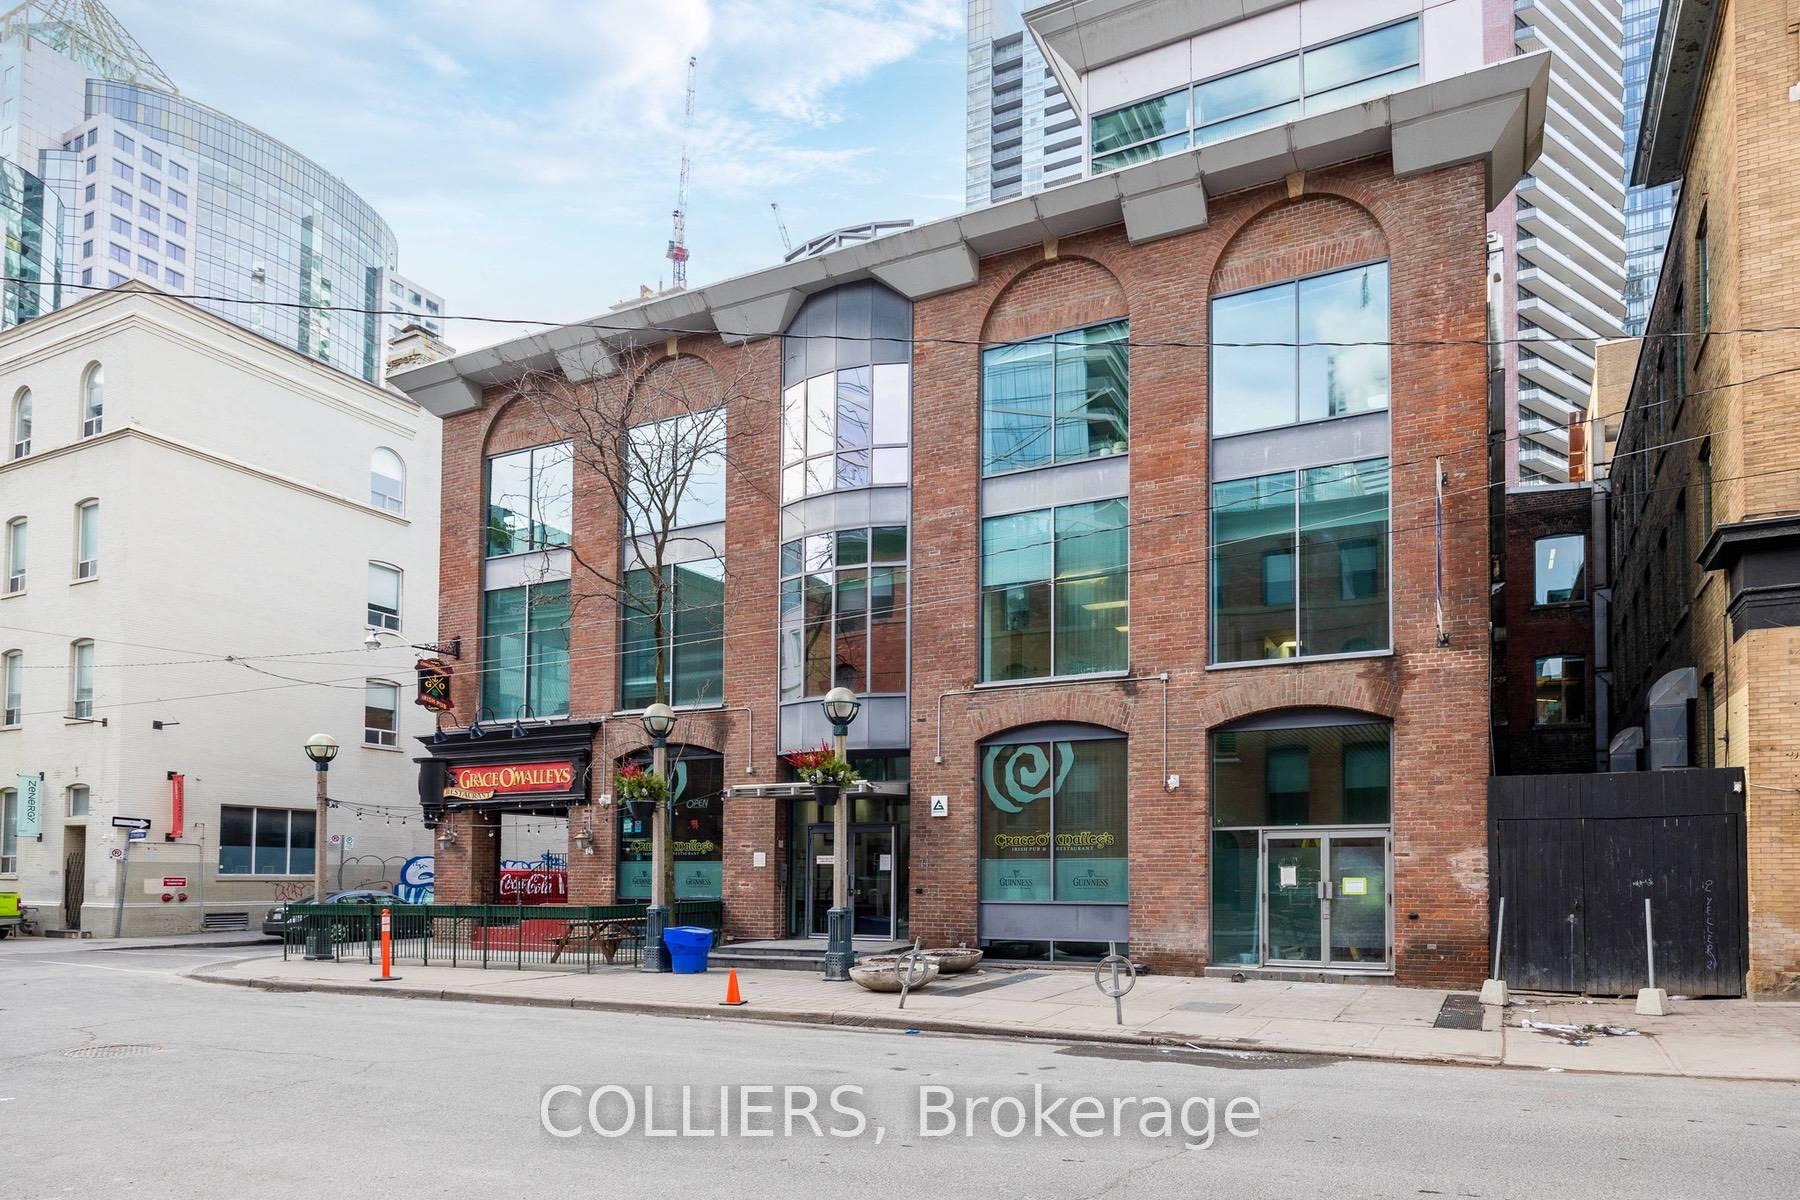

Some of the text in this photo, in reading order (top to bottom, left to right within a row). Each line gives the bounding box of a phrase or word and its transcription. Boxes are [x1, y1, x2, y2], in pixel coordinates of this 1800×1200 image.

[460, 770, 499, 789] GRACE
[686, 799, 709, 808] OPEN
[1000, 878, 1033, 887] GUINNESS
[1072, 878, 1109, 887] GUINNESS
